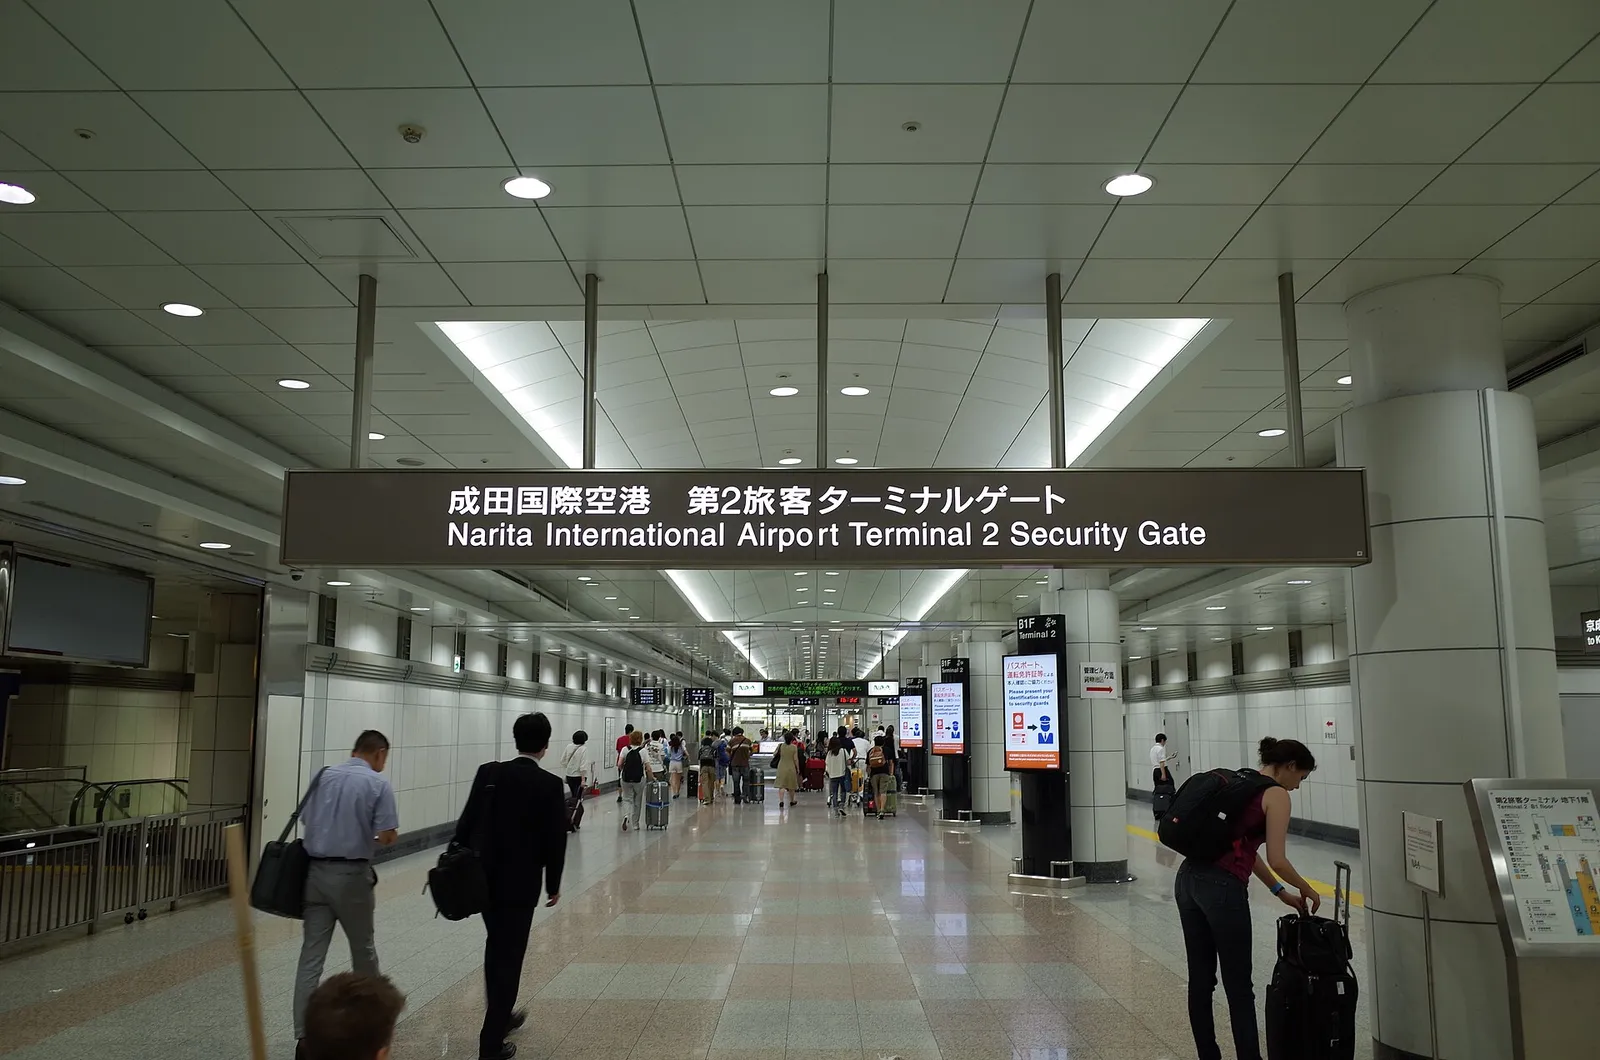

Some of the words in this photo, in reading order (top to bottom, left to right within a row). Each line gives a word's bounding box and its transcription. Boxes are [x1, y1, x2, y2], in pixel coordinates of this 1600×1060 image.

[447, 485, 652, 516] 成田国際空港
[687, 484, 1066, 516] 第2旅客ターミナルゲート
[447, 521, 534, 547] Narita
[546, 521, 725, 547] International
[736, 521, 839, 553] Airport
[848, 521, 972, 547] Terminal
[982, 521, 1000, 546] 2
[1010, 521, 1128, 552] Security
[1138, 520, 1206, 546] Gate
[1018, 617, 1035, 630] B1F
[1019, 630, 1049, 640] Terminal
[1050, 629, 1057, 638] 2
[1587, 636, 1595, 646] to
